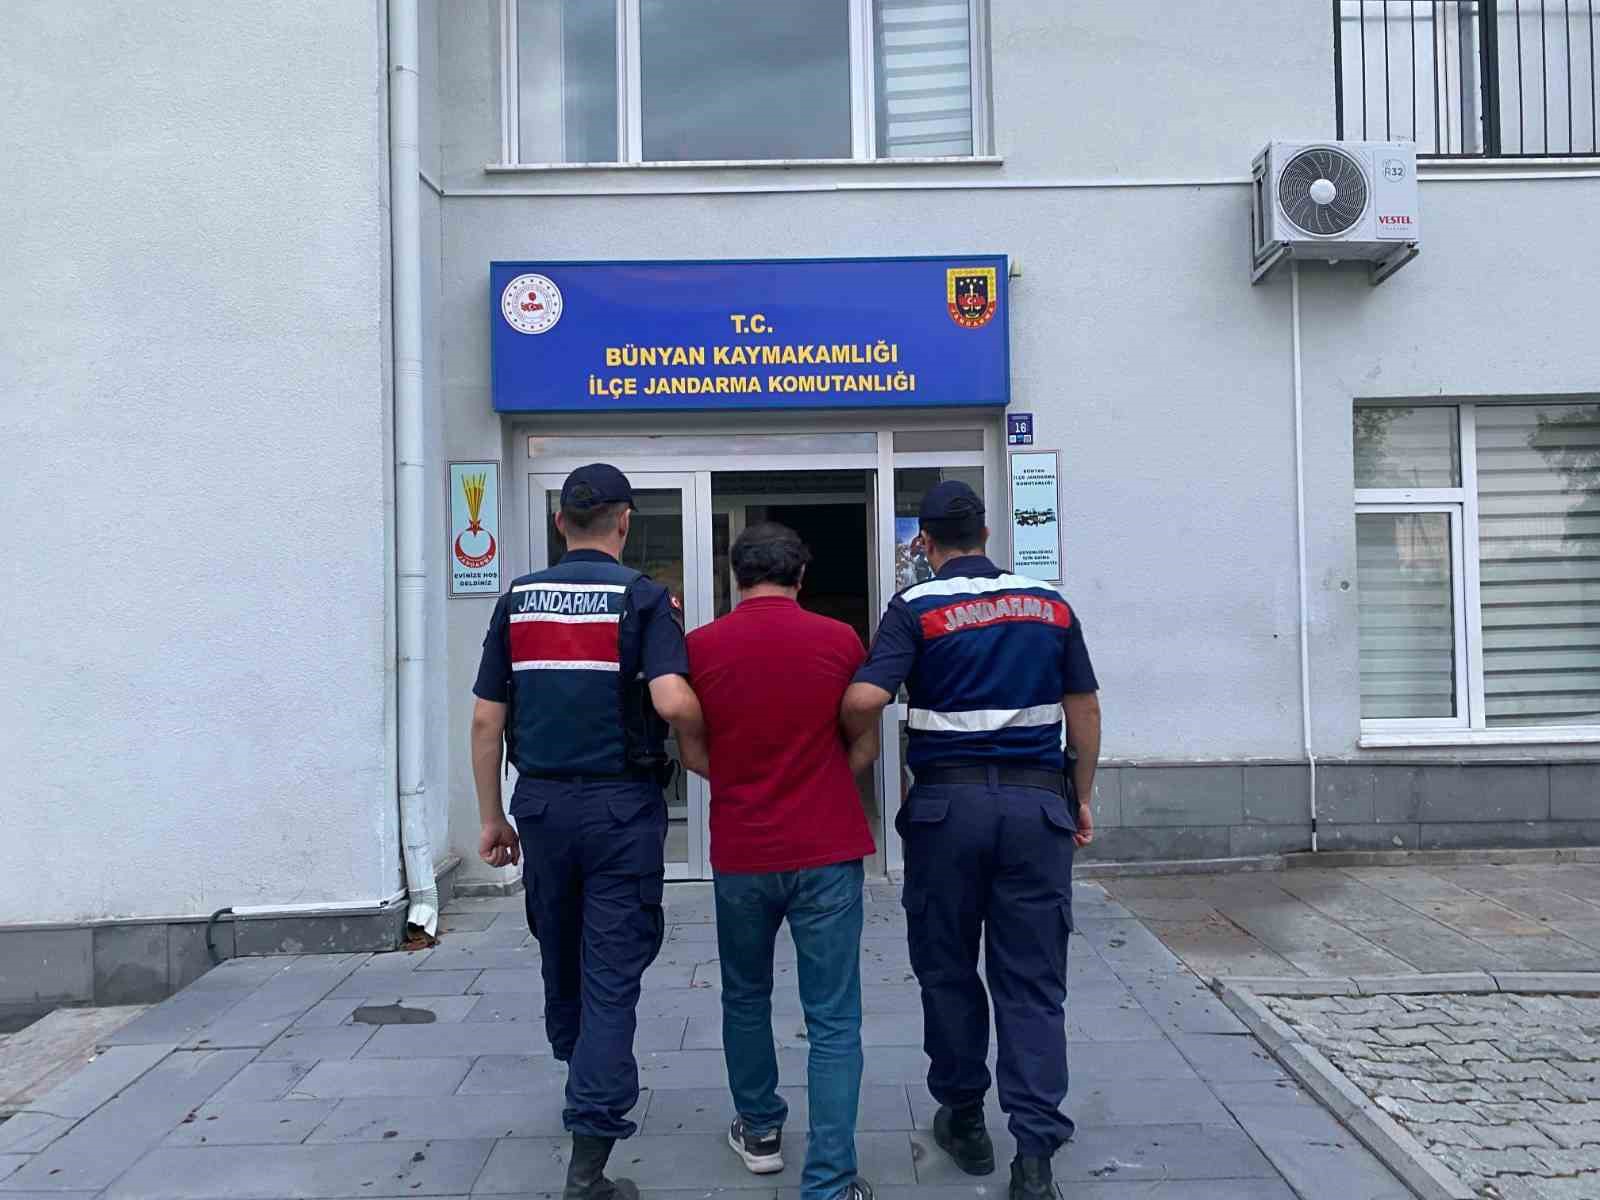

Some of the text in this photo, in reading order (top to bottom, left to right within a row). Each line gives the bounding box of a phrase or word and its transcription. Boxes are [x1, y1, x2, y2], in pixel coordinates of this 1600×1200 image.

[1384, 167, 1404, 177] R32
[1378, 215, 1412, 224] VESTEL
[730, 314, 773, 334] T.C.
[605, 340, 898, 367] BÜNYAN KAYMAKAMLIĞI
[589, 370, 916, 399] İLÇE JANDARMA KOMUTANLIĞI
[1015, 422, 1026, 433] 16
[518, 591, 609, 614] JANDARMA
[943, 598, 1055, 631] JANDARMA
